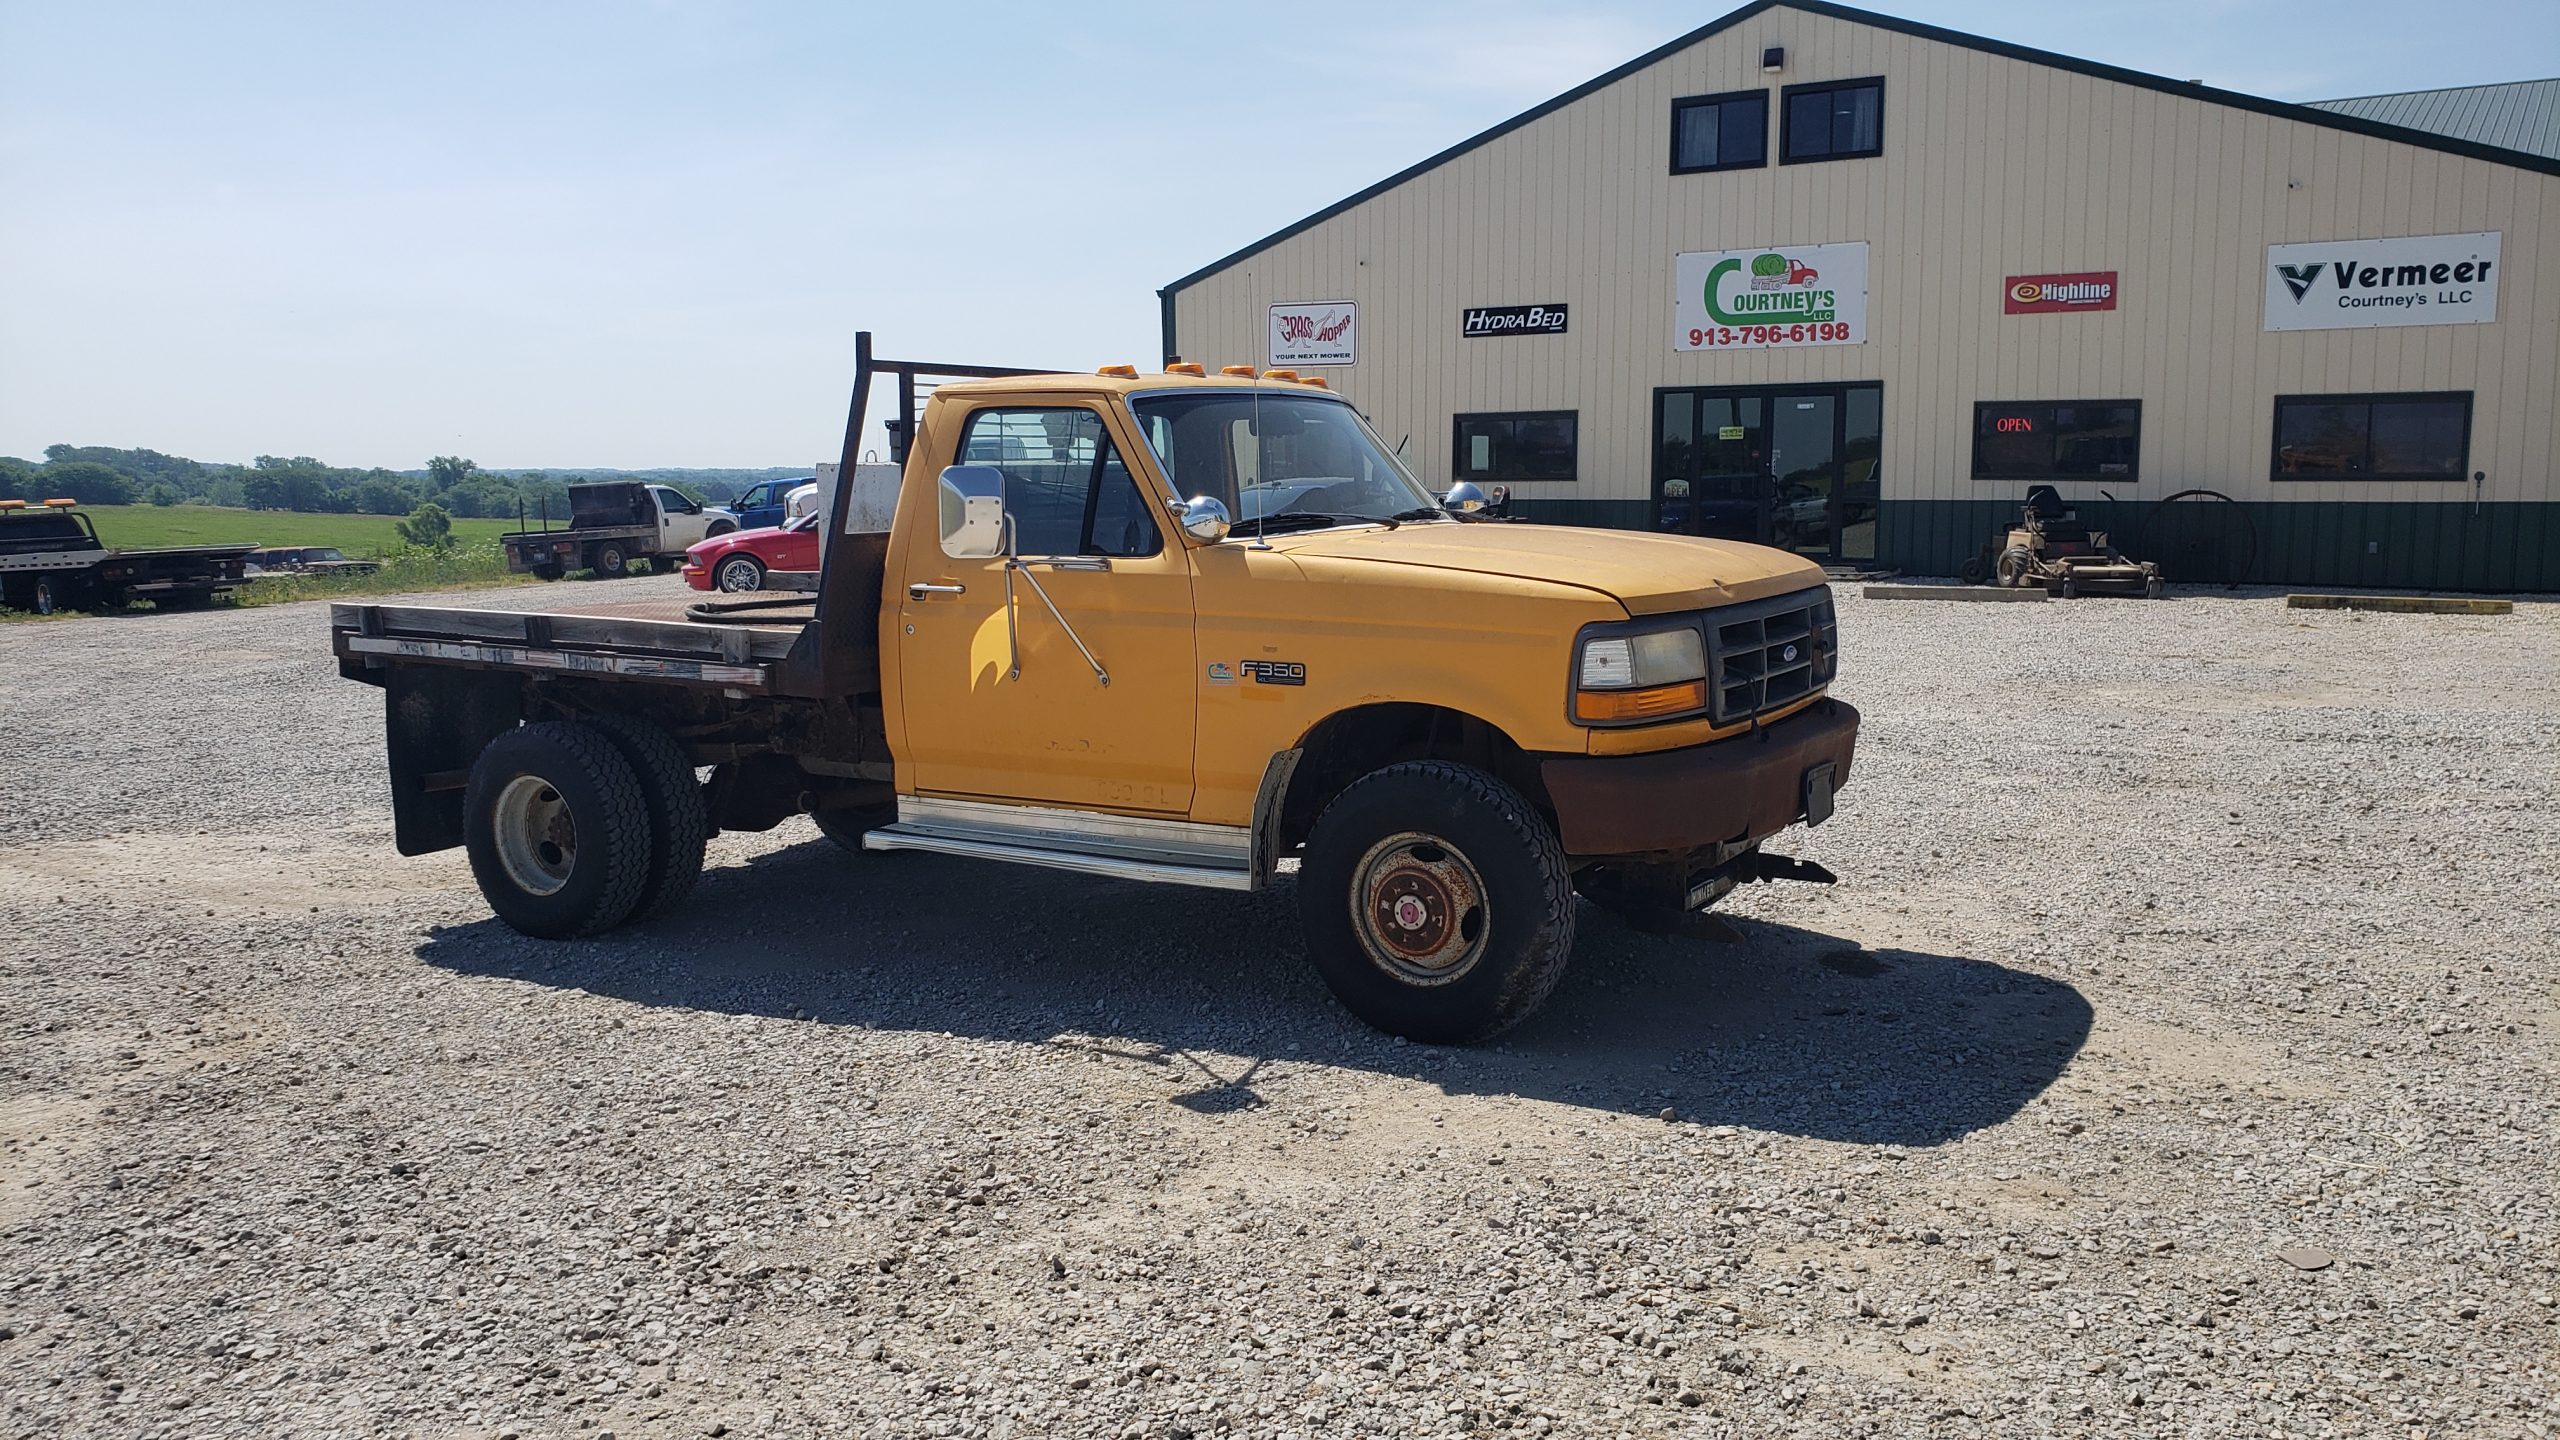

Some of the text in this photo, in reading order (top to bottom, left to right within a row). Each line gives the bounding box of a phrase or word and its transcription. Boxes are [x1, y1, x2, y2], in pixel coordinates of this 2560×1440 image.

[2333, 260, 2492, 289] Vermeer
[2041, 282, 2111, 302] Highline
[2338, 290, 2473, 309] Courtney's LLC
[1813, 311, 1832, 321] LLC
[1688, 322, 1851, 347] 913-796-6198
[1996, 417, 2033, 433] OPEN
